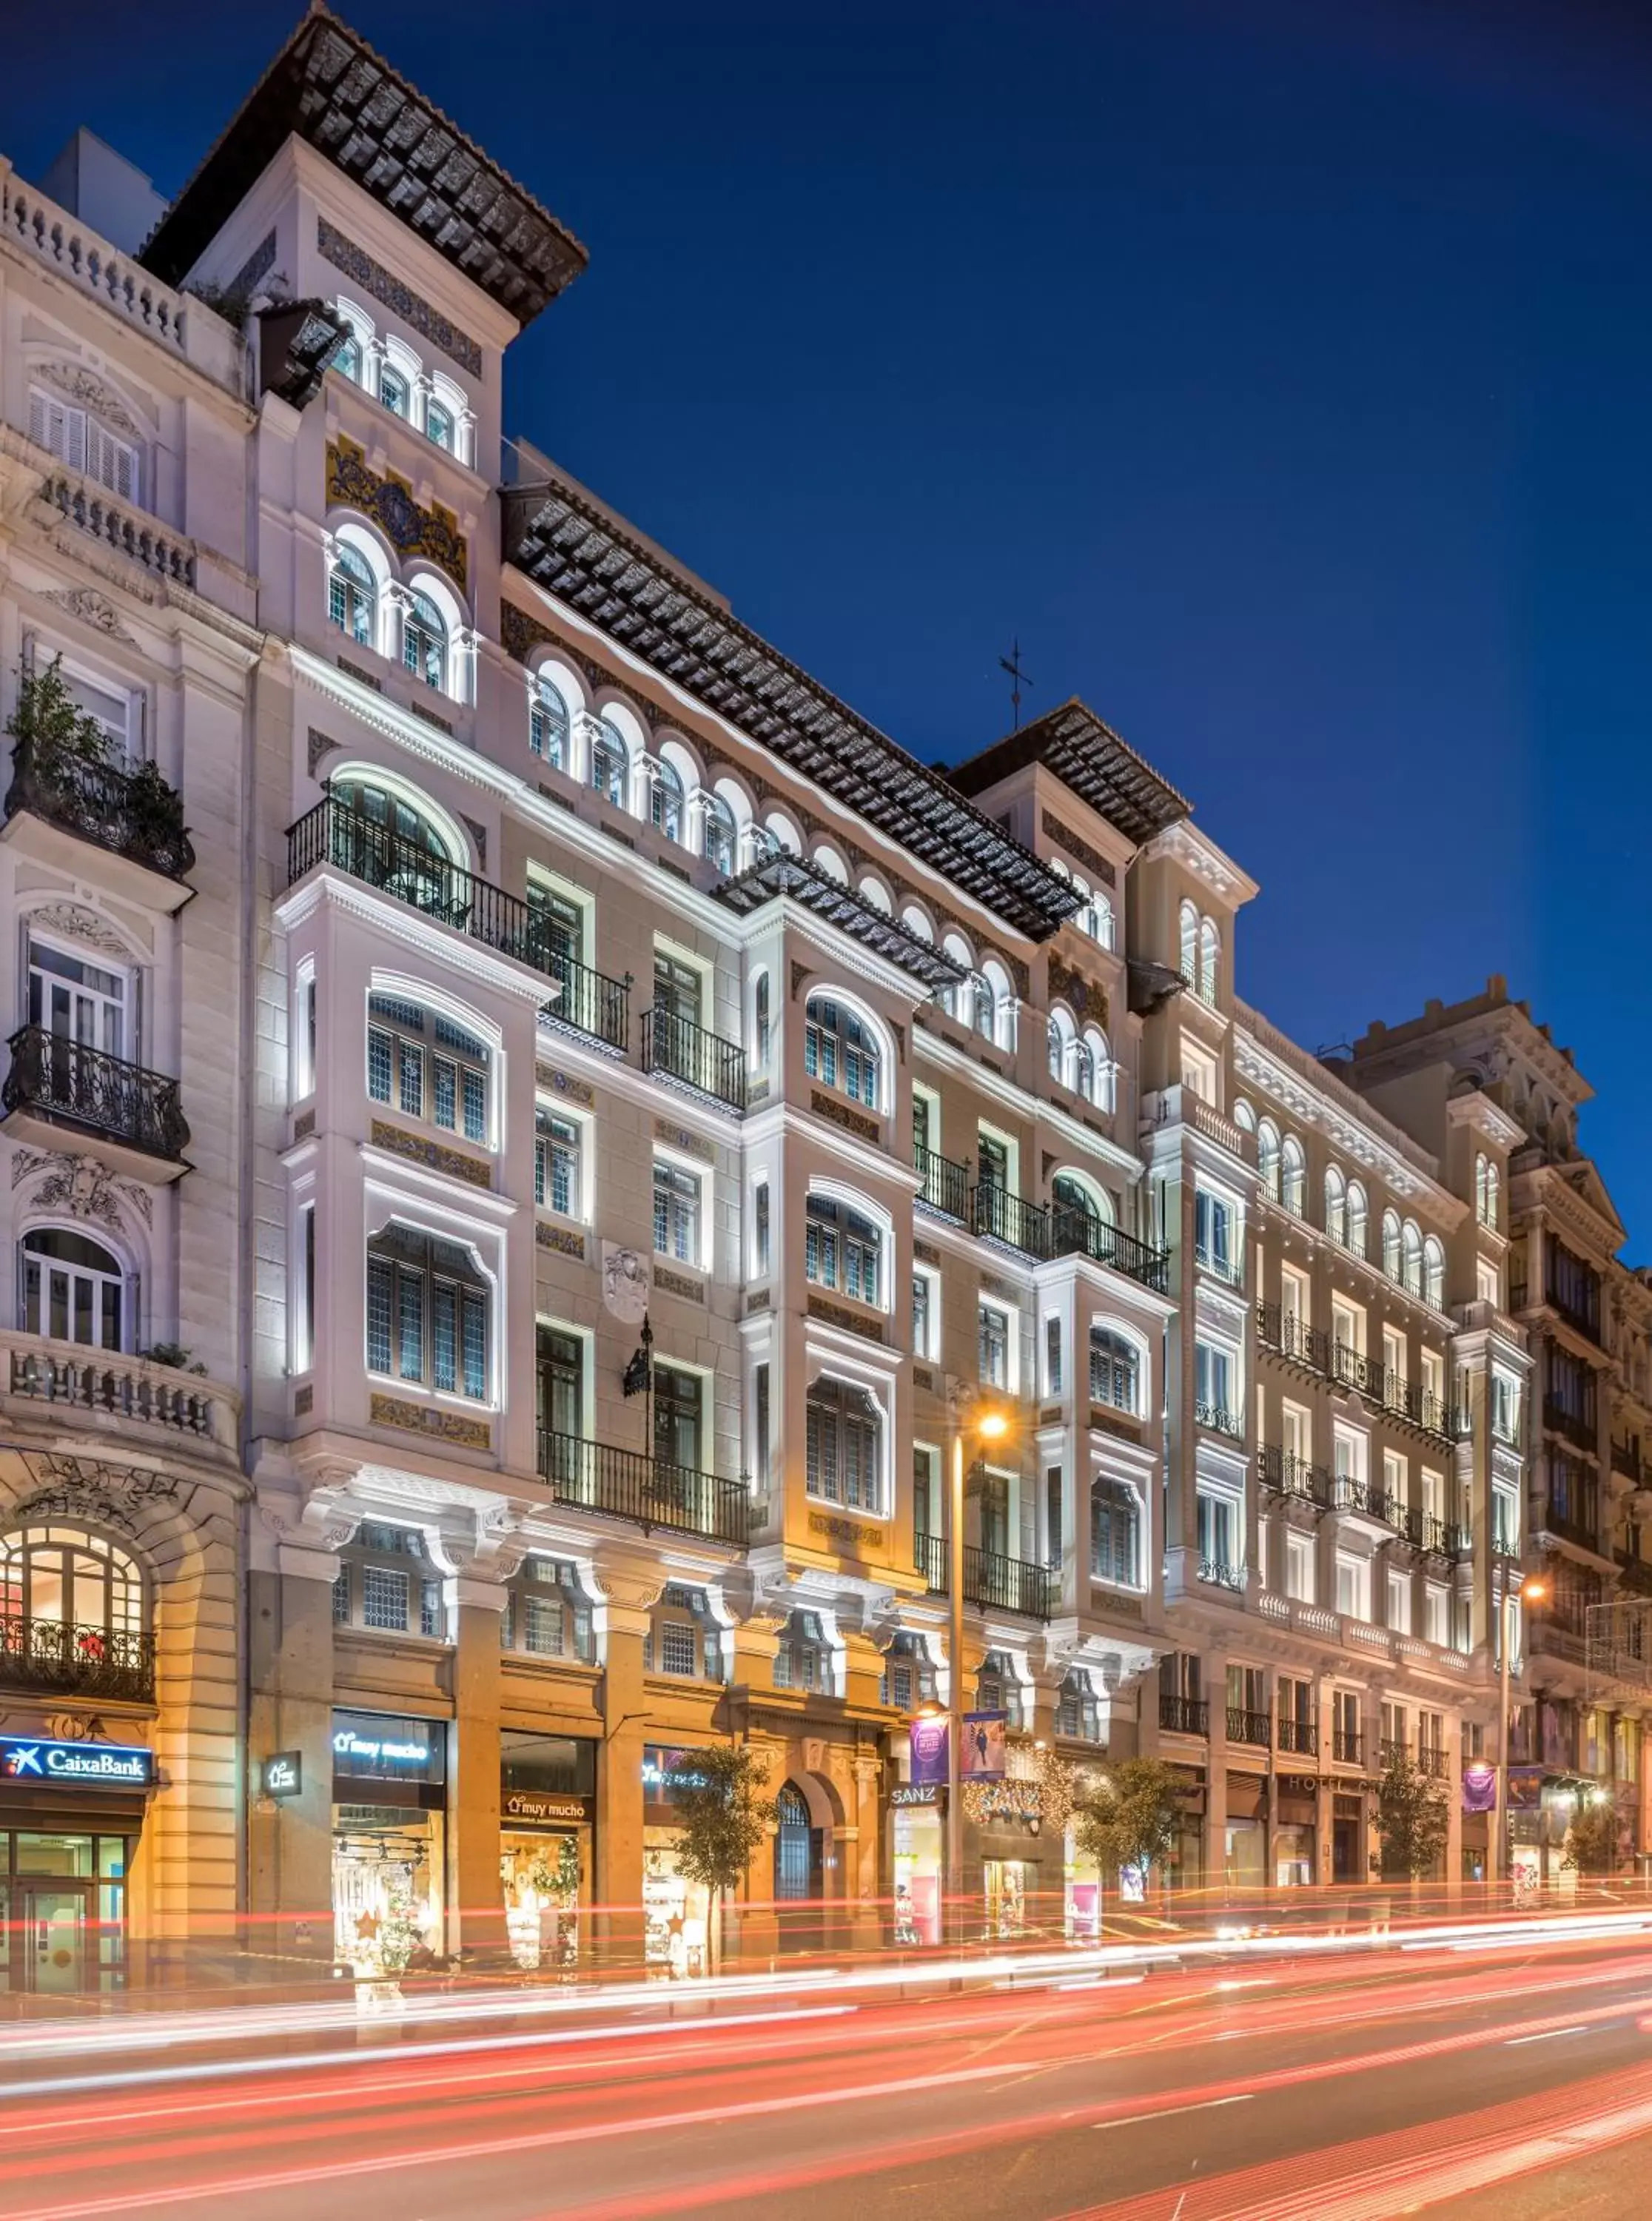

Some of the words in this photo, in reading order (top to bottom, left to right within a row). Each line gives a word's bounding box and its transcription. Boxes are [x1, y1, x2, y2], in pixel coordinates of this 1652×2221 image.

[47, 1749, 145, 1776] CaixaBank
[1289, 1777, 1345, 1792] HOTEL
[891, 1786, 936, 1804] SANZ
[522, 1803, 545, 1818] muy
[548, 1803, 585, 1818] mucho
